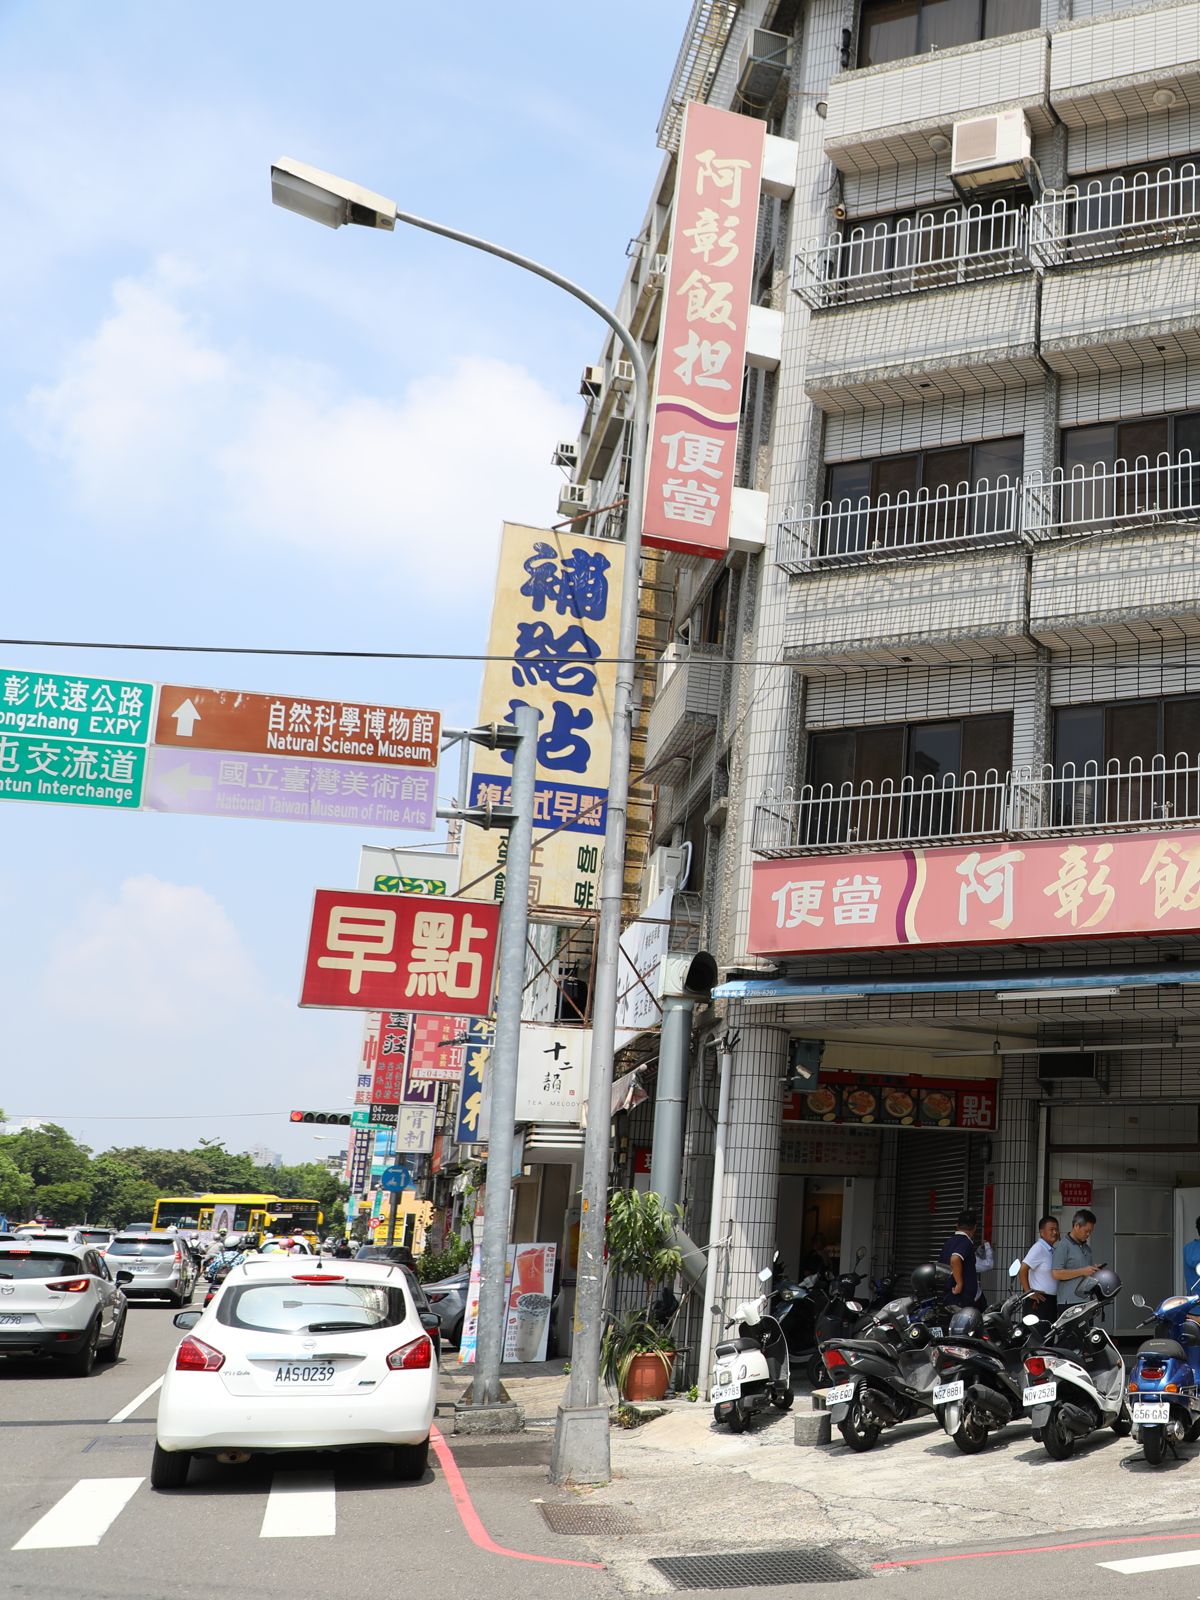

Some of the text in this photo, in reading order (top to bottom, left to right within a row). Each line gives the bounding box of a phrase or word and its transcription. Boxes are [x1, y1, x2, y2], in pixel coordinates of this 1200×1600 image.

[672, 148, 752, 392] 阿彰飯担
[659, 429, 725, 527] 便當
[502, 542, 611, 773] 補給站
[3, 674, 144, 718] 彰快速公路
[89, 715, 142, 737] EXPY
[268, 700, 434, 744] 自然科學博物館
[266, 731, 432, 761] Natural Science Museum
[37, 778, 133, 803] Interchange
[217, 759, 430, 802] 國立臺灣美術館
[215, 791, 427, 824] National Taiwan Museum of Fine Arts
[573, 844, 599, 909] 咖啡
[771, 873, 882, 929] 便當
[317, 905, 488, 998] 早點
[962, 1095, 991, 1126] 點
[275, 1366, 335, 1382] AAS-0239
